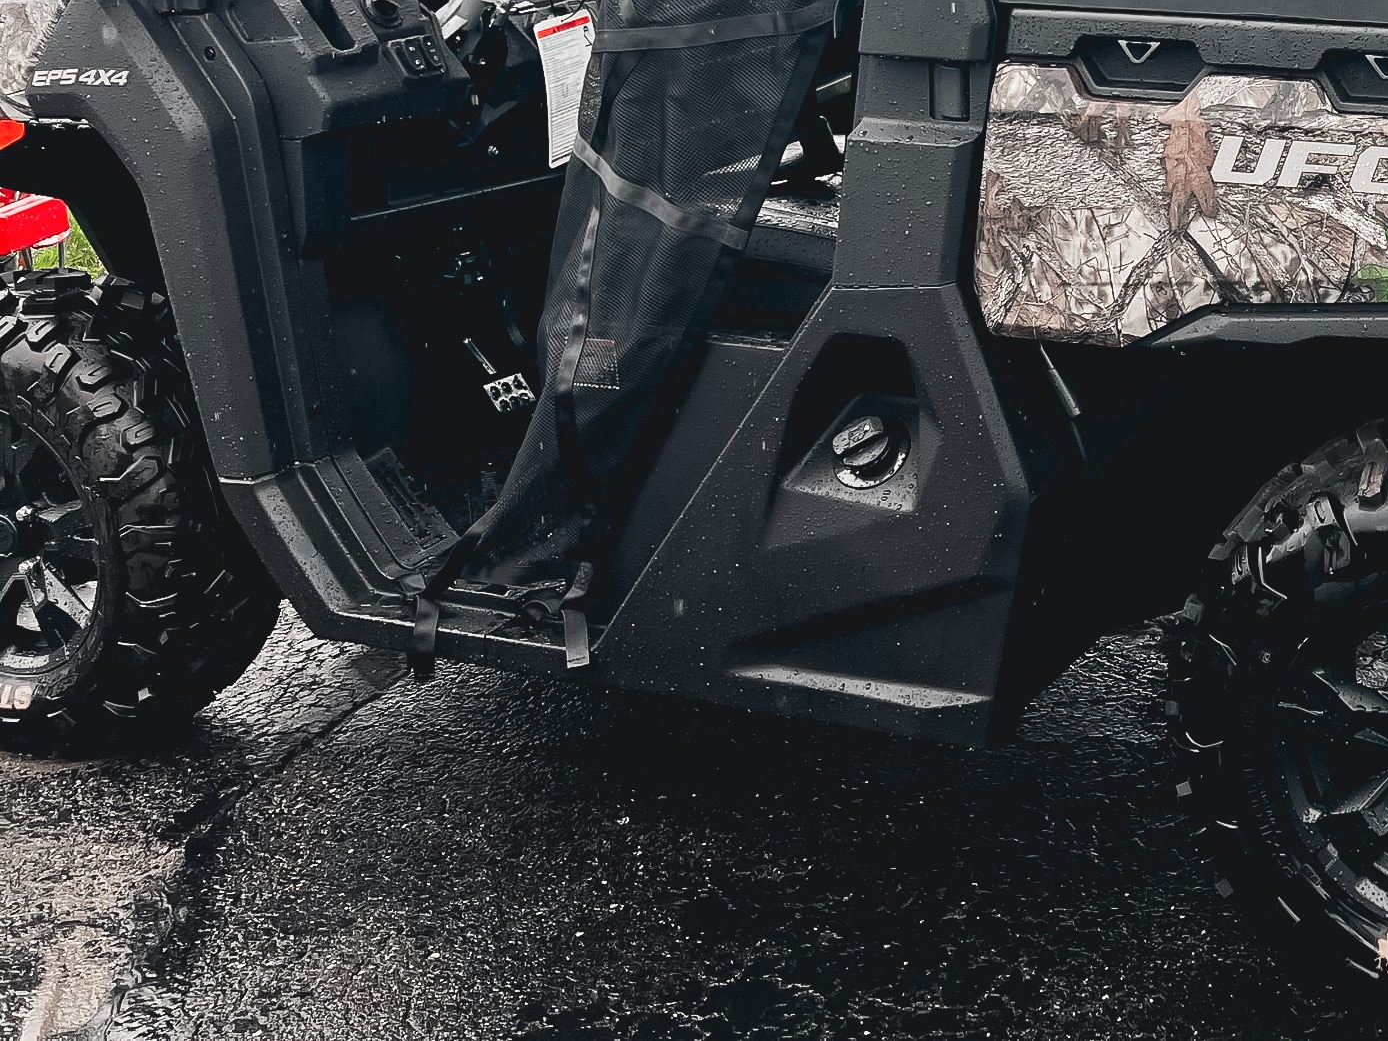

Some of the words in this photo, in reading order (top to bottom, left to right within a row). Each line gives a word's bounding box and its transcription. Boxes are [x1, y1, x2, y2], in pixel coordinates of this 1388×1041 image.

[32, 68, 78, 86] EPS
[79, 69, 130, 86] 4X4
[0, 683, 33, 711] ST
